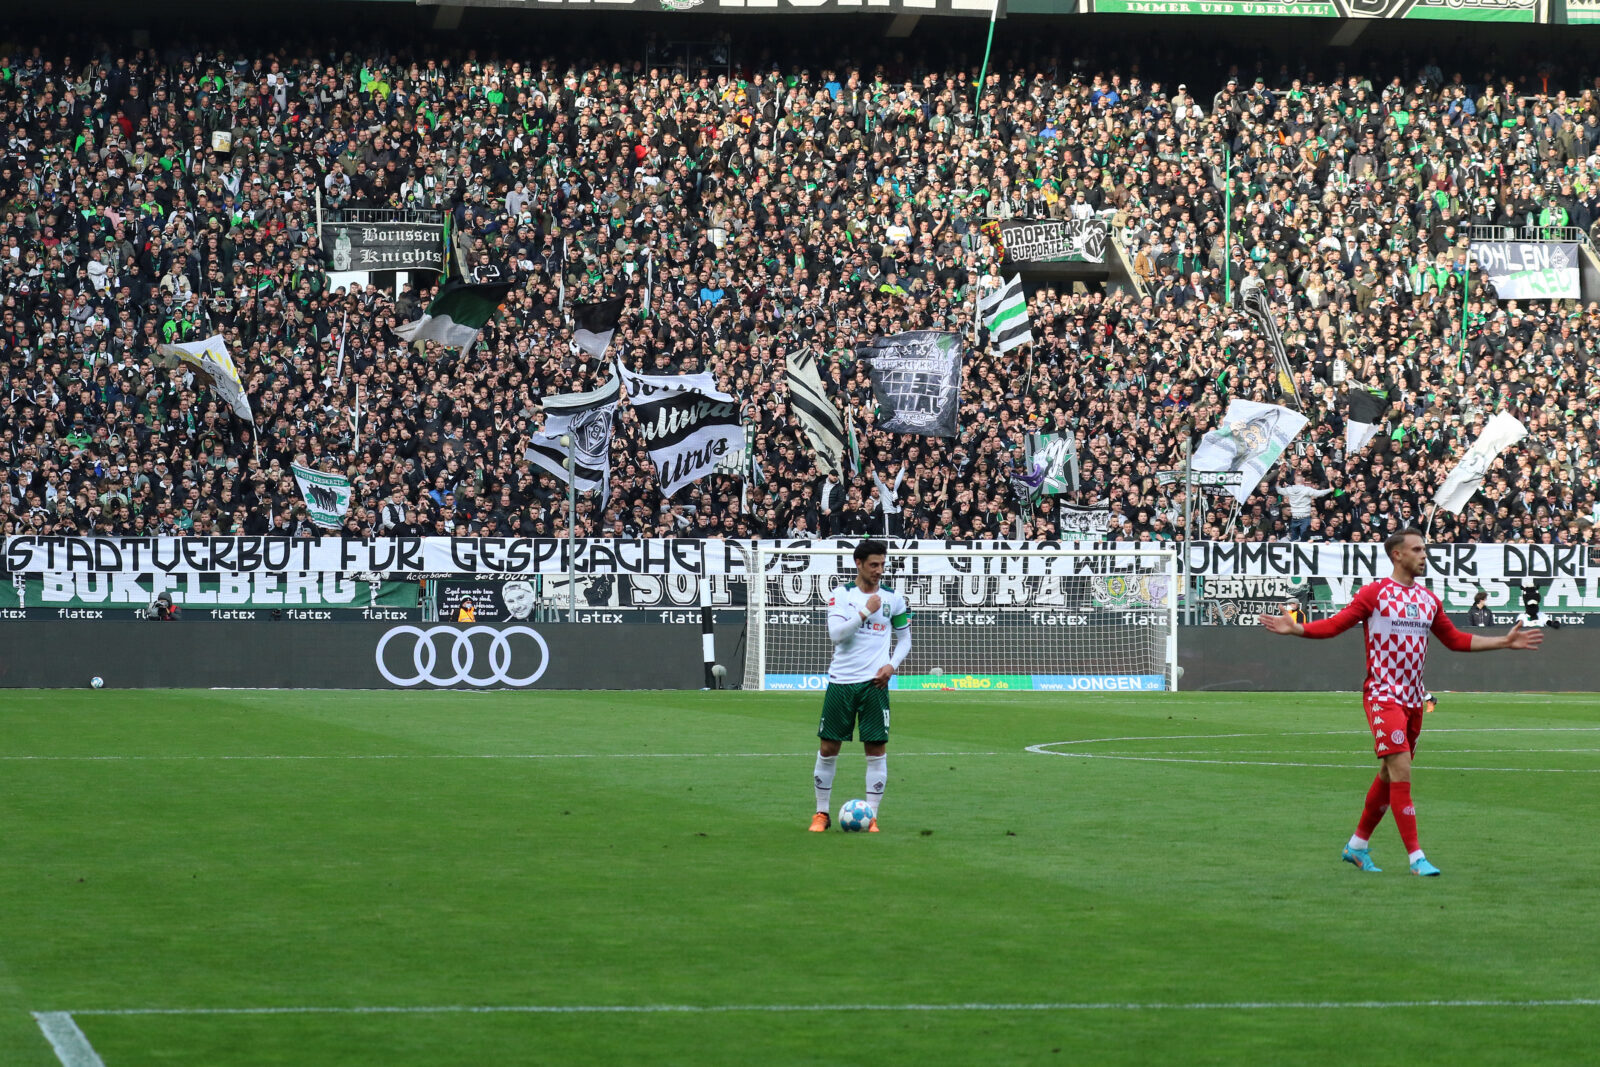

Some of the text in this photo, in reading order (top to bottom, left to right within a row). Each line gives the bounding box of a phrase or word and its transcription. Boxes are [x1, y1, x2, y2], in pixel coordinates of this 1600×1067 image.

[1126, 2, 1329, 15] IMMER UND ÜBERALL!
[361, 227, 440, 244] Borussen
[1003, 219, 1081, 247] DROPKIK
[360, 249, 442, 264] Knights
[8, 536, 321, 572] STADTVERBOT
[341, 536, 424, 571] FÜR
[451, 537, 702, 574] GESPRÄCHE
[725, 539, 811, 574] AUS
[837, 540, 918, 574] DM
[945, 540, 1062, 575] GYM?
[1343, 544, 1378, 576] IN
[1425, 544, 1478, 576] ER
[1504, 544, 1585, 577] DDR!
[1204, 579, 1287, 598] SERVICE
[57, 609, 103, 619] flatex
[210, 609, 255, 620] flatex
[286, 609, 331, 620] flatex
[362, 610, 407, 620] flatex
[940, 612, 996, 625] flatex
[1031, 612, 1088, 625] flatex
[1123, 613, 1178, 626] flate
[1492, 613, 1514, 624] tex
[1549, 613, 1585, 624] latex
[797, 676, 829, 689] JON
[921, 681, 949, 689] www.
[994, 680, 1009, 689] .de
[1040, 682, 1065, 690] www.
[1068, 677, 1142, 690] JONGEN
